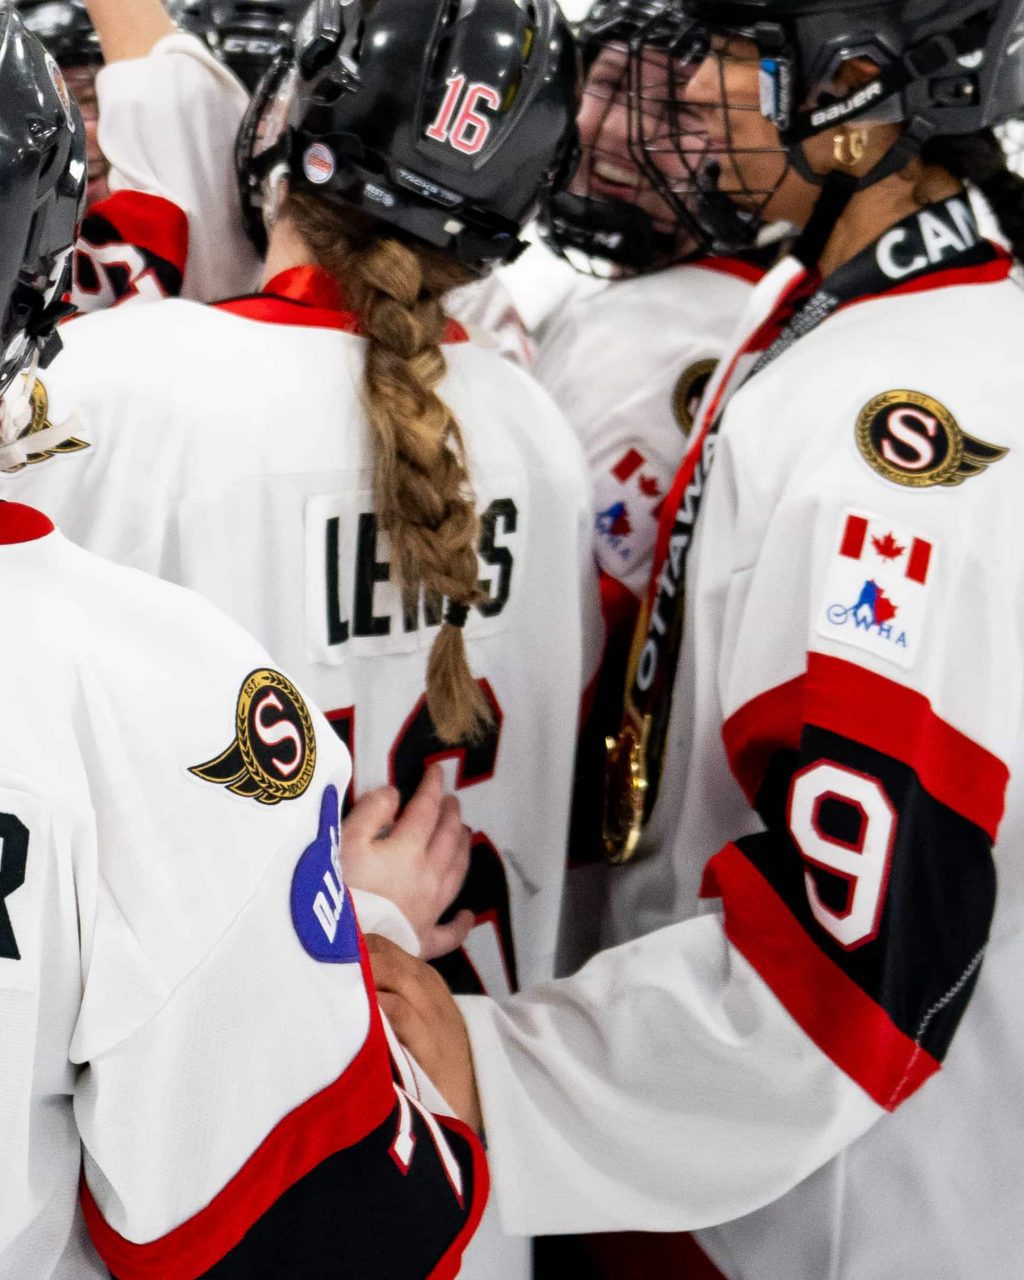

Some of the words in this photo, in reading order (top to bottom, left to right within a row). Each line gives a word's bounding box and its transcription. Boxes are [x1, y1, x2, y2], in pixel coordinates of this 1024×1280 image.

[425, 73, 502, 156] 16
[810, 81, 882, 127] BAUER
[881, 407, 938, 470] S
[325, 497, 519, 648] LES
[254, 690, 303, 777] S
[786, 757, 899, 953] 9
